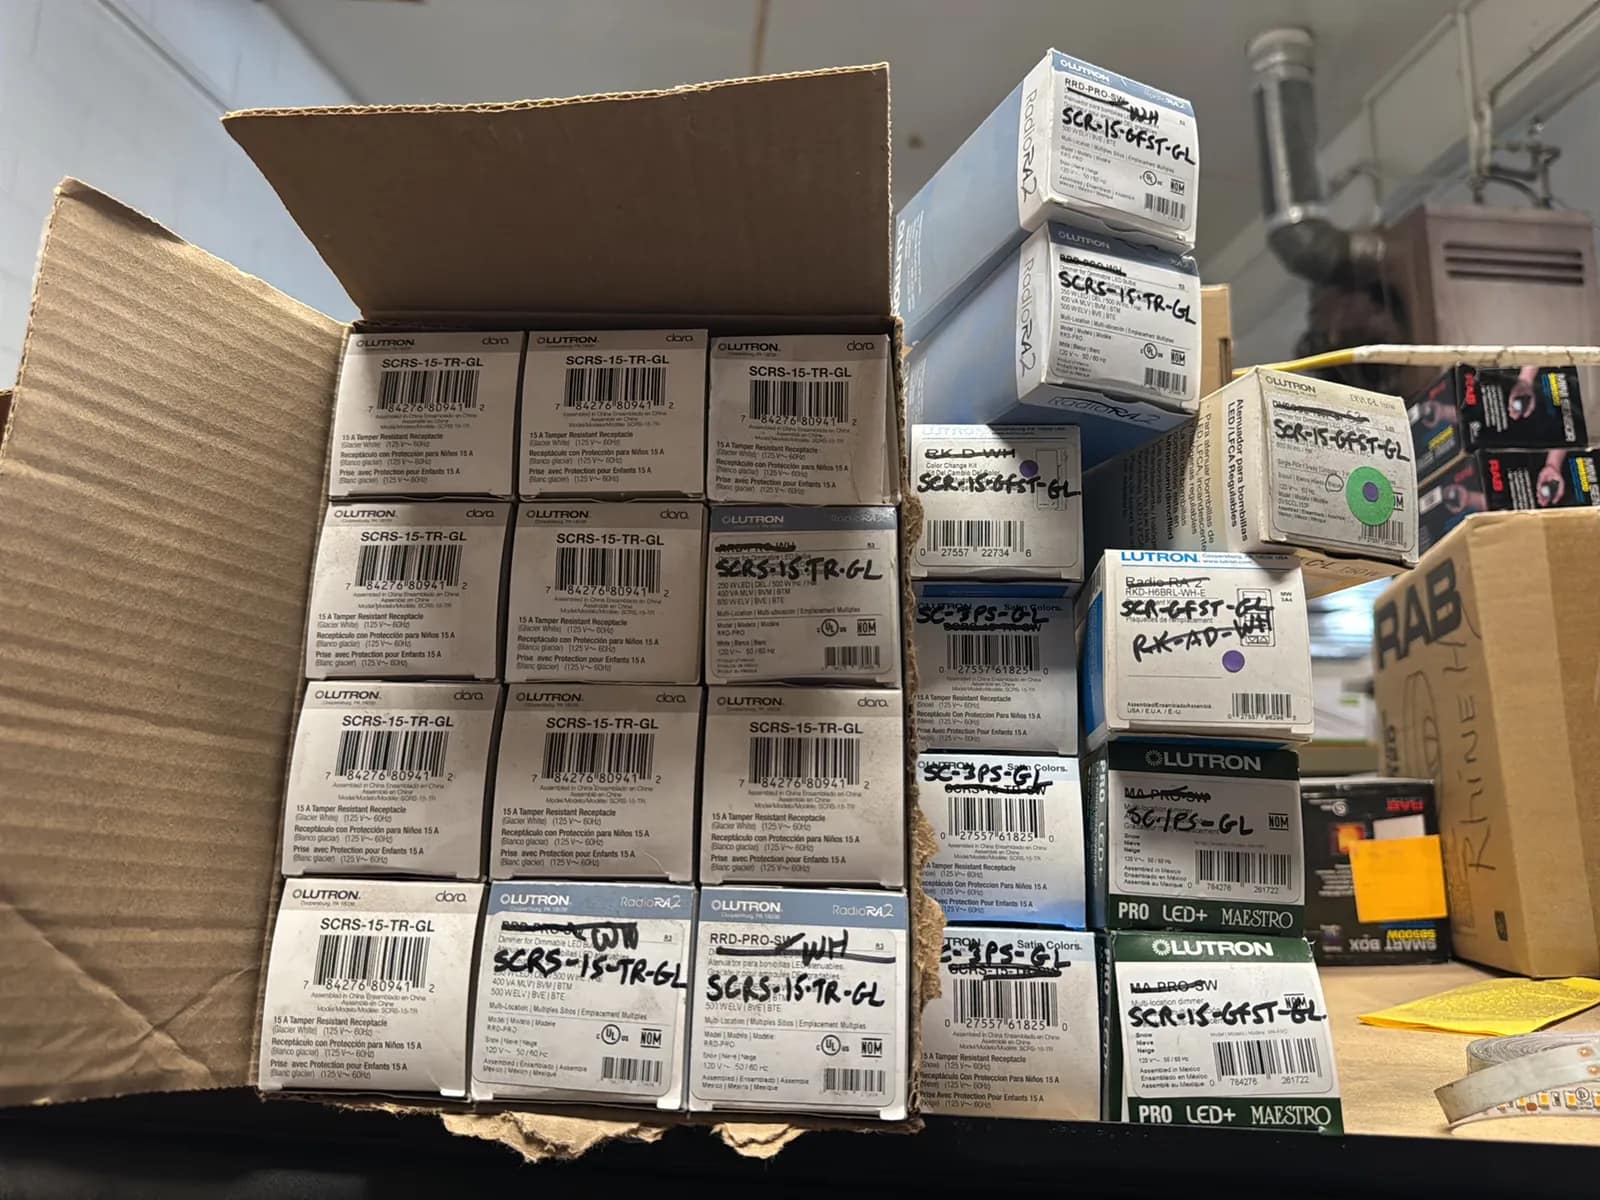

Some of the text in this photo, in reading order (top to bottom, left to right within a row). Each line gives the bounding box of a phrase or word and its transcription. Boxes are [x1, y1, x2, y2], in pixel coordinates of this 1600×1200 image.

[1067, 62, 1109, 81] LUTRON
[1066, 233, 1110, 248] LUTRON
[365, 339, 414, 347] LUTRON
[546, 336, 597, 344] LUTRON
[728, 343, 778, 351] LUTRON
[382, 357, 483, 368] SCRS-15-TR-GL
[566, 355, 669, 365] SCRS-15-TR-GL
[749, 366, 851, 377] SCRS-15-TR-GL
[1273, 378, 1315, 393] LUTRON
[388, 404, 463, 412] 84276 80941
[576, 402, 611, 410] 84276
[761, 416, 796, 424] 84276
[1236, 399, 1244, 455] Atenuador
[1227, 466, 1237, 527] Regulables
[1238, 485, 1248, 541] bombillas
[361, 532, 467, 541] SCRS-15-TR-GL
[557, 534, 664, 545] SCRS-15-TR-GL
[942, 549, 1009, 557] 27557 22734
[1121, 552, 1198, 562] LUTRON
[367, 582, 444, 590] 84276 80941
[568, 586, 646, 596] 84276 80941
[1373, 560, 1462, 672] RAB
[857, 620, 876, 635] NOM
[958, 665, 1028, 675] 27557 61825
[325, 691, 379, 699] LUTRON
[728, 697, 782, 705] LUTRON
[343, 716, 454, 727] SCRS-15-TR-GL
[546, 718, 658, 729] SCRS-15-TR-GL
[750, 722, 863, 733] SCRS-15-TR-GL
[1164, 752, 1262, 770] LUTRON
[348, 771, 429, 781] 84276 80941
[554, 774, 637, 783] 84276 80941
[762, 778, 845, 788] 84276 80941
[520, 809, 543, 817] Tamper
[579, 809, 616, 817] Receptacle
[1269, 815, 1288, 829] NOM
[960, 831, 1033, 841] 27557 61825
[302, 890, 360, 900] LUTRON
[511, 895, 569, 905] LUTRON
[722, 901, 781, 912] LUTRON
[1119, 902, 1293, 929] PRO LED+ MAESTRO
[321, 918, 435, 932] SCRS-15-TR-GL
[1170, 941, 1273, 956] LUTRON
[326, 981, 410, 991] 84276 80941
[290, 1017, 314, 1025] Tamper
[317, 1017, 348, 1025] Resistant
[350, 1018, 387, 1027] Receptacle
[967, 1018, 1045, 1030] 27557 61825
[641, 1031, 661, 1045] NOM
[862, 1040, 882, 1055] NOM
[271, 1060, 287, 1068] Prise
[310, 1061, 344, 1069] Protection
[347, 1063, 362, 1071] pour
[364, 1062, 390, 1070] Enfants
[1230, 1076, 1309, 1086] 784276 261722
[1139, 1105, 1331, 1125] PRO LED+ MAESTRO
